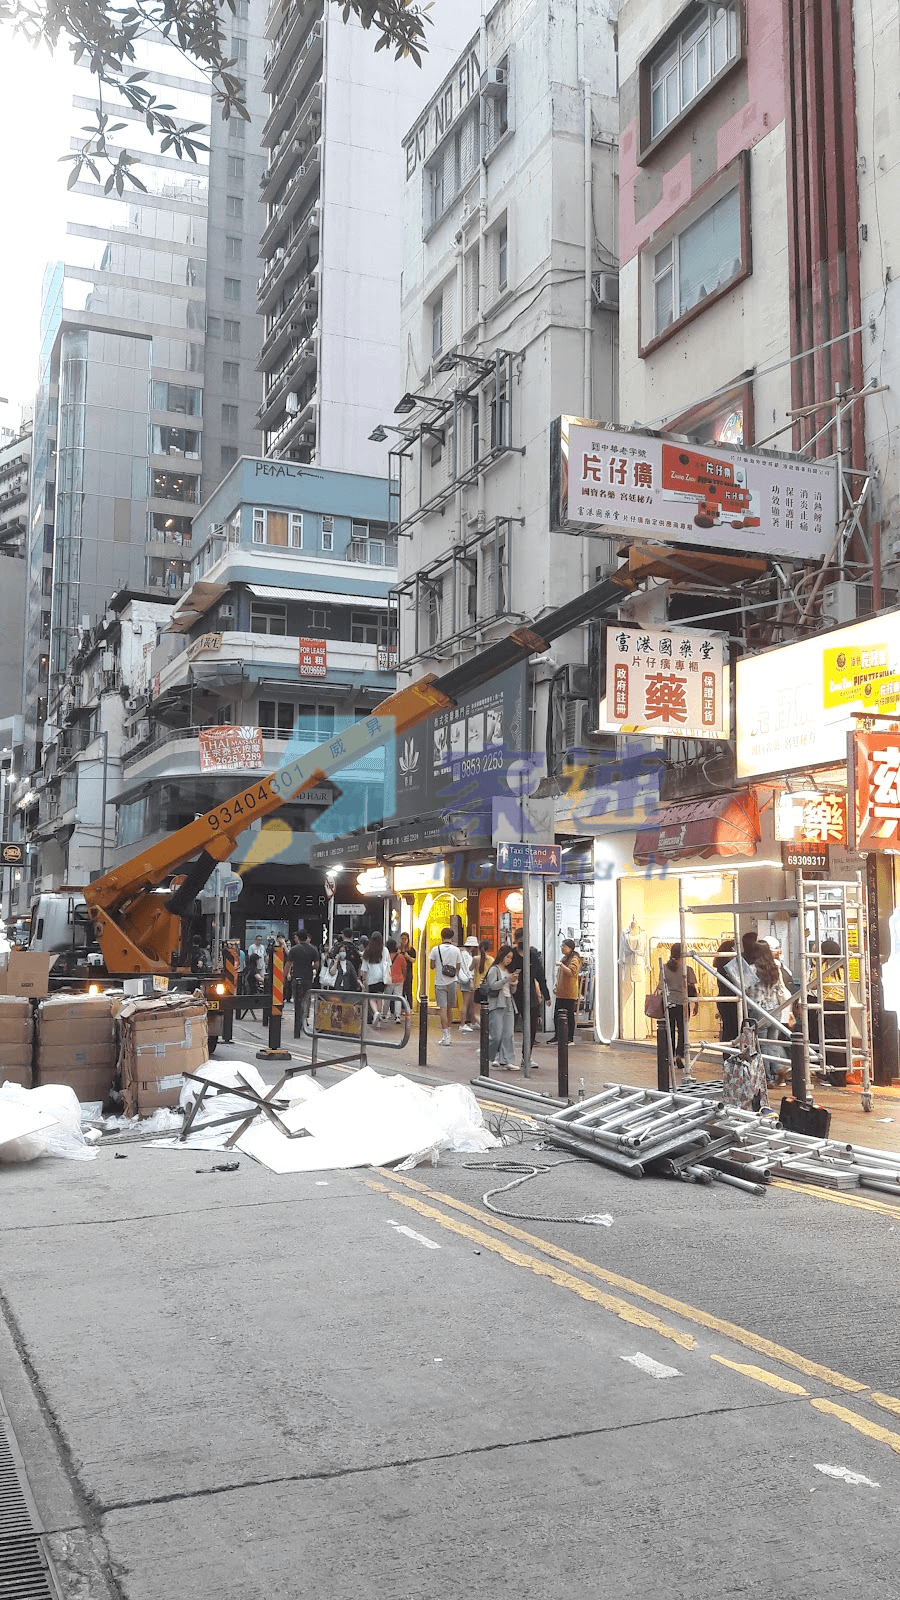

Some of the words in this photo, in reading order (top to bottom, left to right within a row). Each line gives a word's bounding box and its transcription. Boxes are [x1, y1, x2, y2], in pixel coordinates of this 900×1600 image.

[581, 452, 653, 489] 片仔癀
[784, 486, 795, 530] 保肝護肝
[799, 488, 809, 532] 消炎止痛
[300, 646, 311, 654] FOR
[311, 647, 326, 655] LEASE
[303, 655, 324, 665] 出租
[615, 631, 715, 660] 富港國藥堂
[631, 655, 700, 673] 片仔癀專櫃
[616, 668, 627, 715] 政府註冊
[643, 671, 689, 723] 藥
[703, 675, 714, 722] 保證正貨
[200, 738, 230, 752] THAI
[215, 755, 239, 765] 2628
[240, 752, 261, 762] 3289
[461, 757, 481, 779] 9853
[482, 750, 504, 773] 2253
[207, 762, 305, 830] 93404301
[802, 794, 844, 841] 藥
[513, 858, 542, 868] 的士站
[525, 847, 547, 856] Stand
[787, 855, 826, 866] 69309317
[267, 894, 326, 907] RAZER
